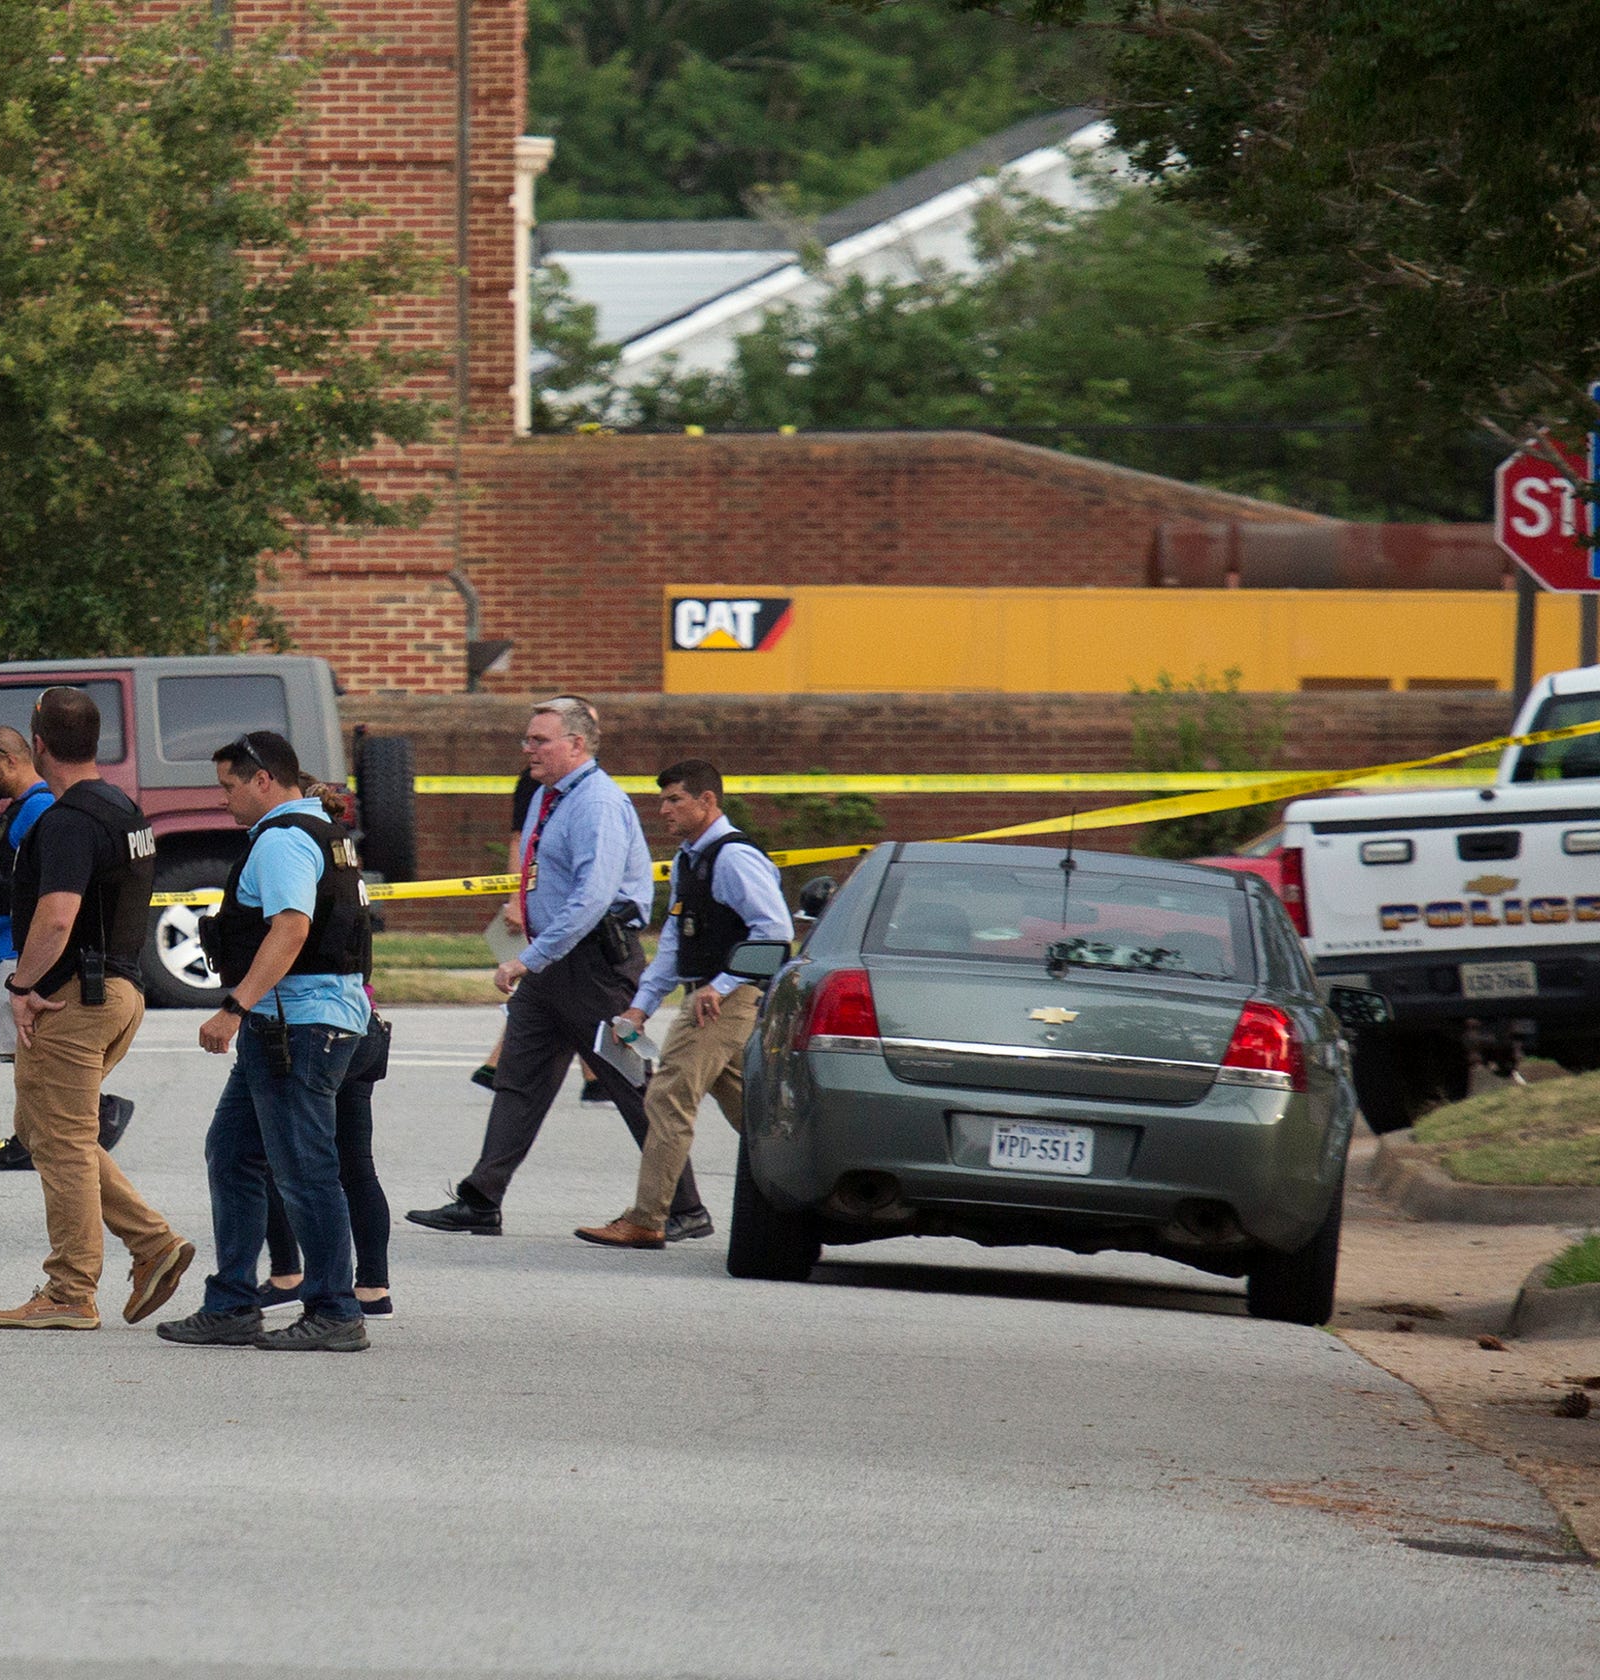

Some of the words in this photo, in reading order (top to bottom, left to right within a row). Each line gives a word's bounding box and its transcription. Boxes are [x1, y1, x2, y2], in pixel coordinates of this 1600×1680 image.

[1510, 476, 1576, 538] ST
[675, 599, 762, 649] CAT
[1380, 896, 1600, 930] POLICE
[996, 1134, 1086, 1163] WPD-5513
